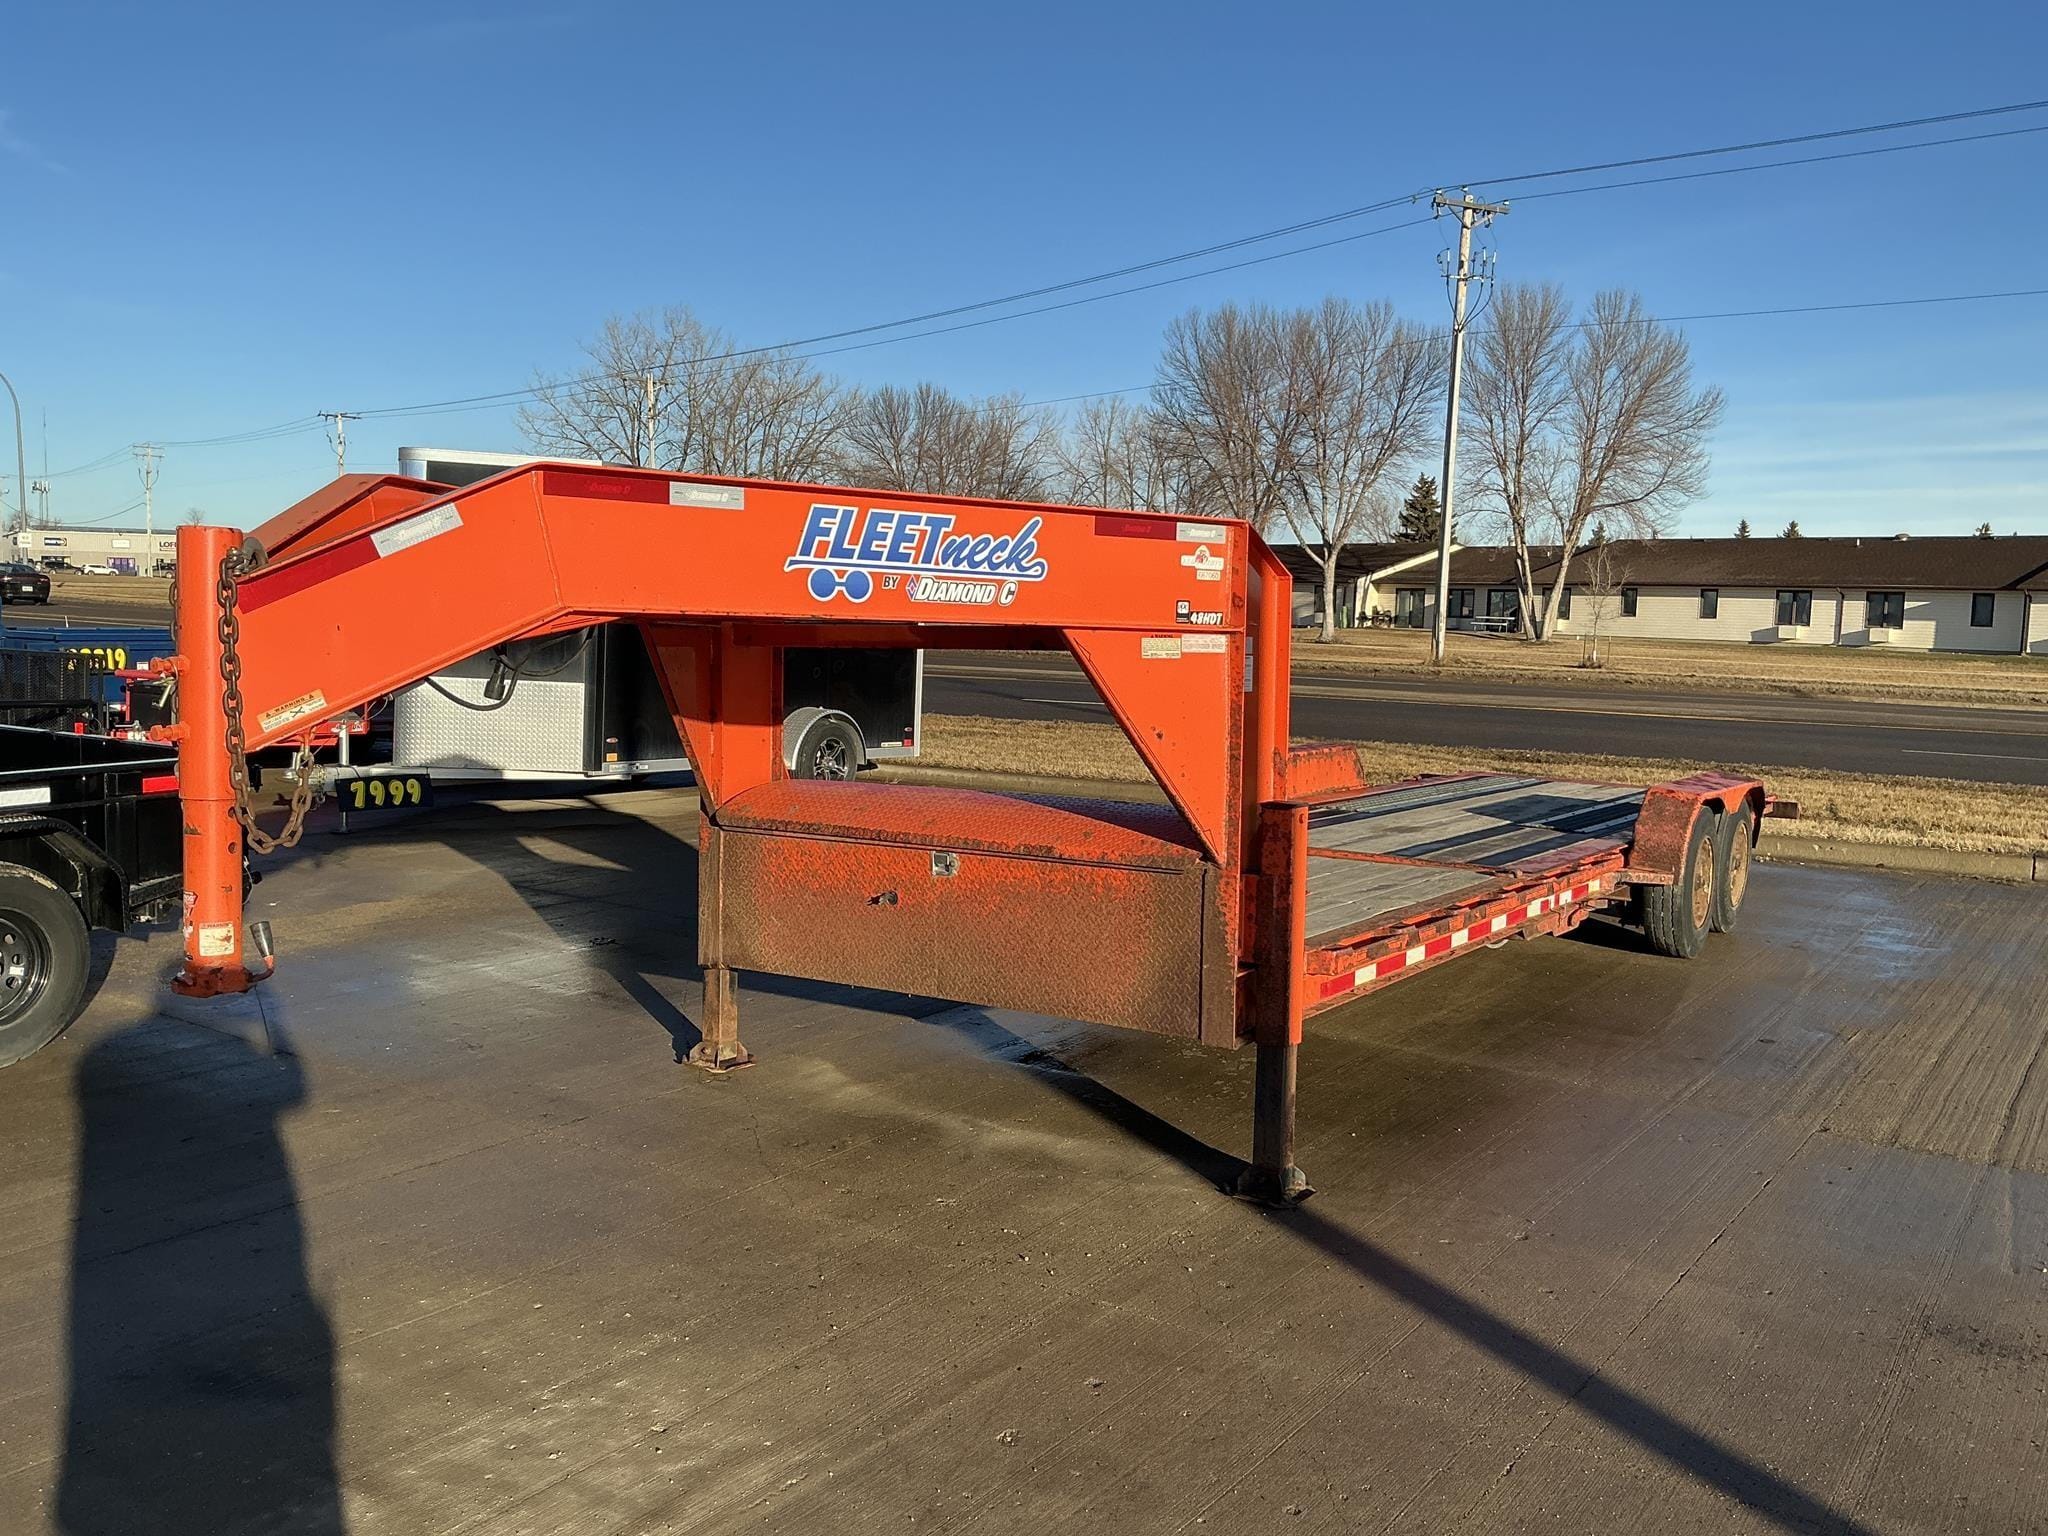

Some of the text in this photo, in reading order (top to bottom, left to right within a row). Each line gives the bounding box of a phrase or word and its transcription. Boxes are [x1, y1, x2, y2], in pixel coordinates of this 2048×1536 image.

[883, 576, 1017, 605] BY DIAMOND C
[351, 778, 421, 809] 7999
